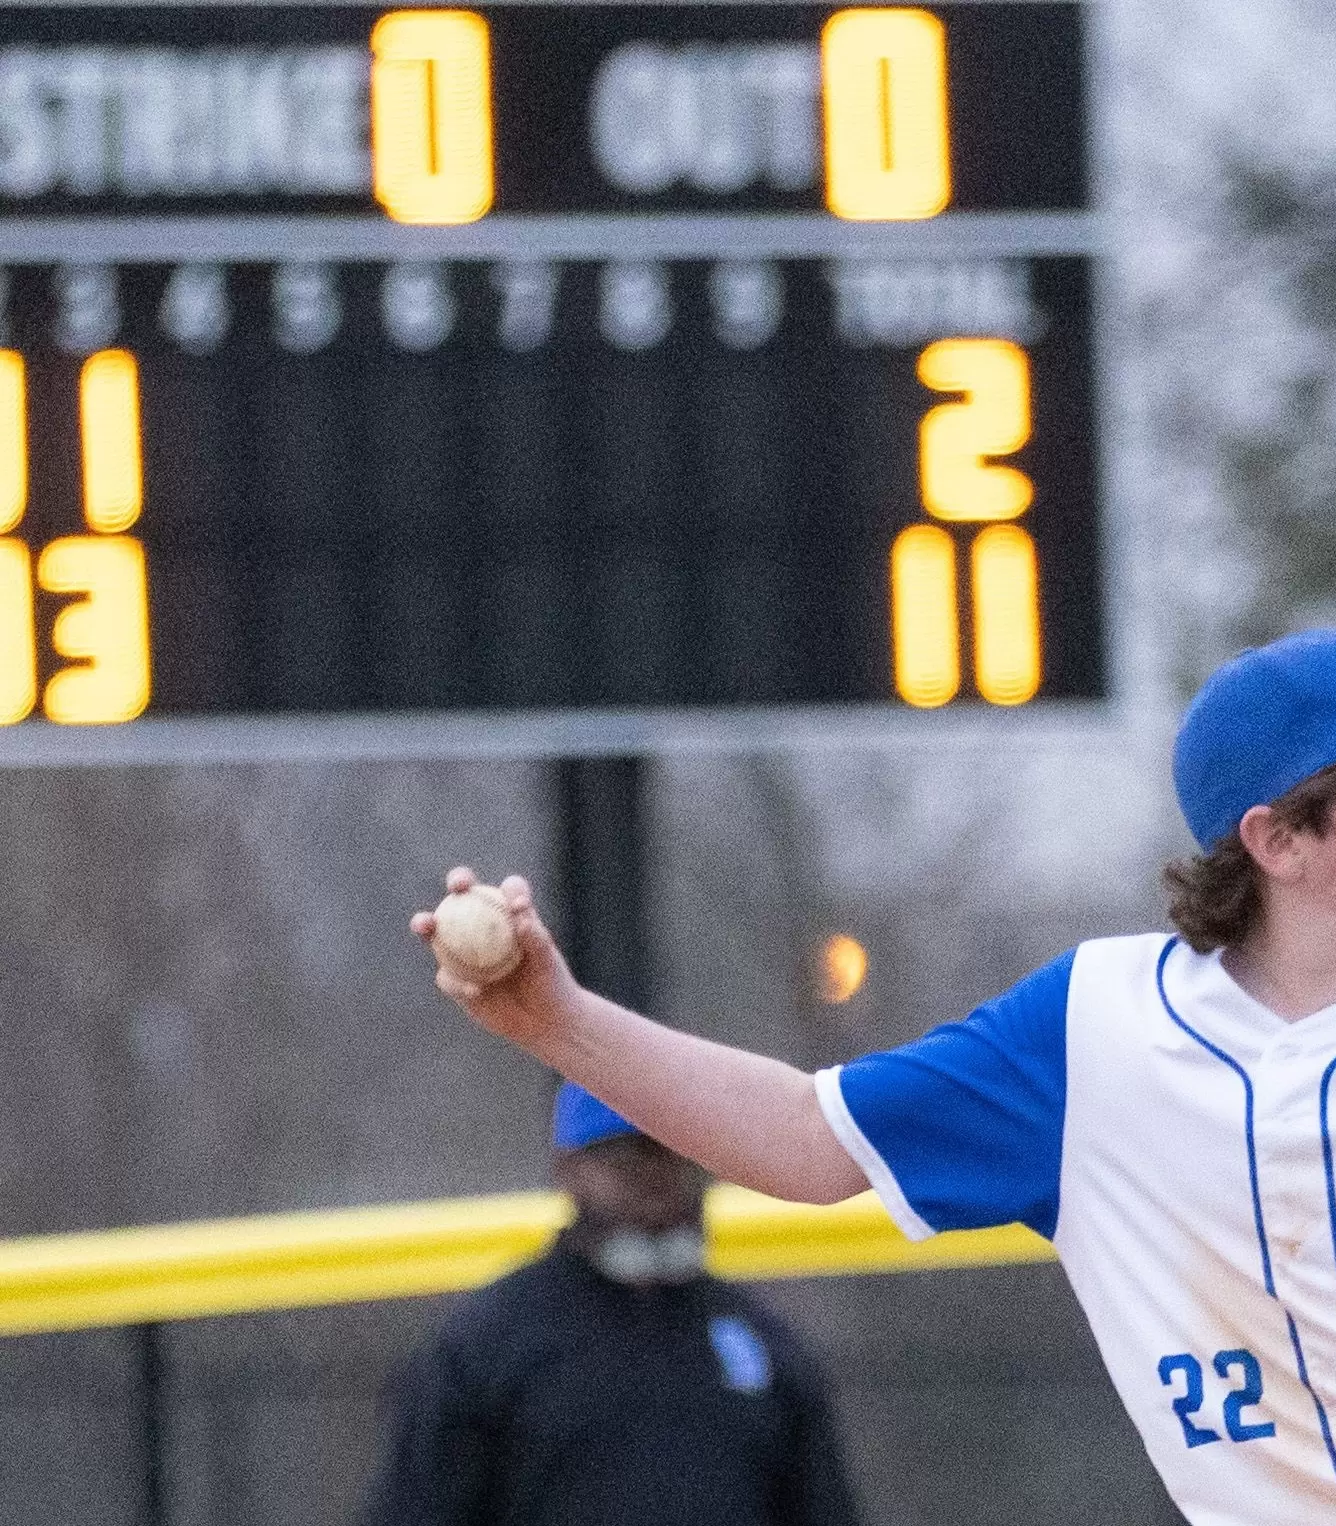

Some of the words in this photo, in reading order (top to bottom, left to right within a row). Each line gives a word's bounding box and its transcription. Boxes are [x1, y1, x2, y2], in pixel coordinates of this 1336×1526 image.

[591, 40, 820, 193] OUT
[820, 7, 952, 221] 0
[916, 336, 1034, 522] 2
[891, 523, 1042, 708] 11
[1157, 1347, 1277, 1449] 22
